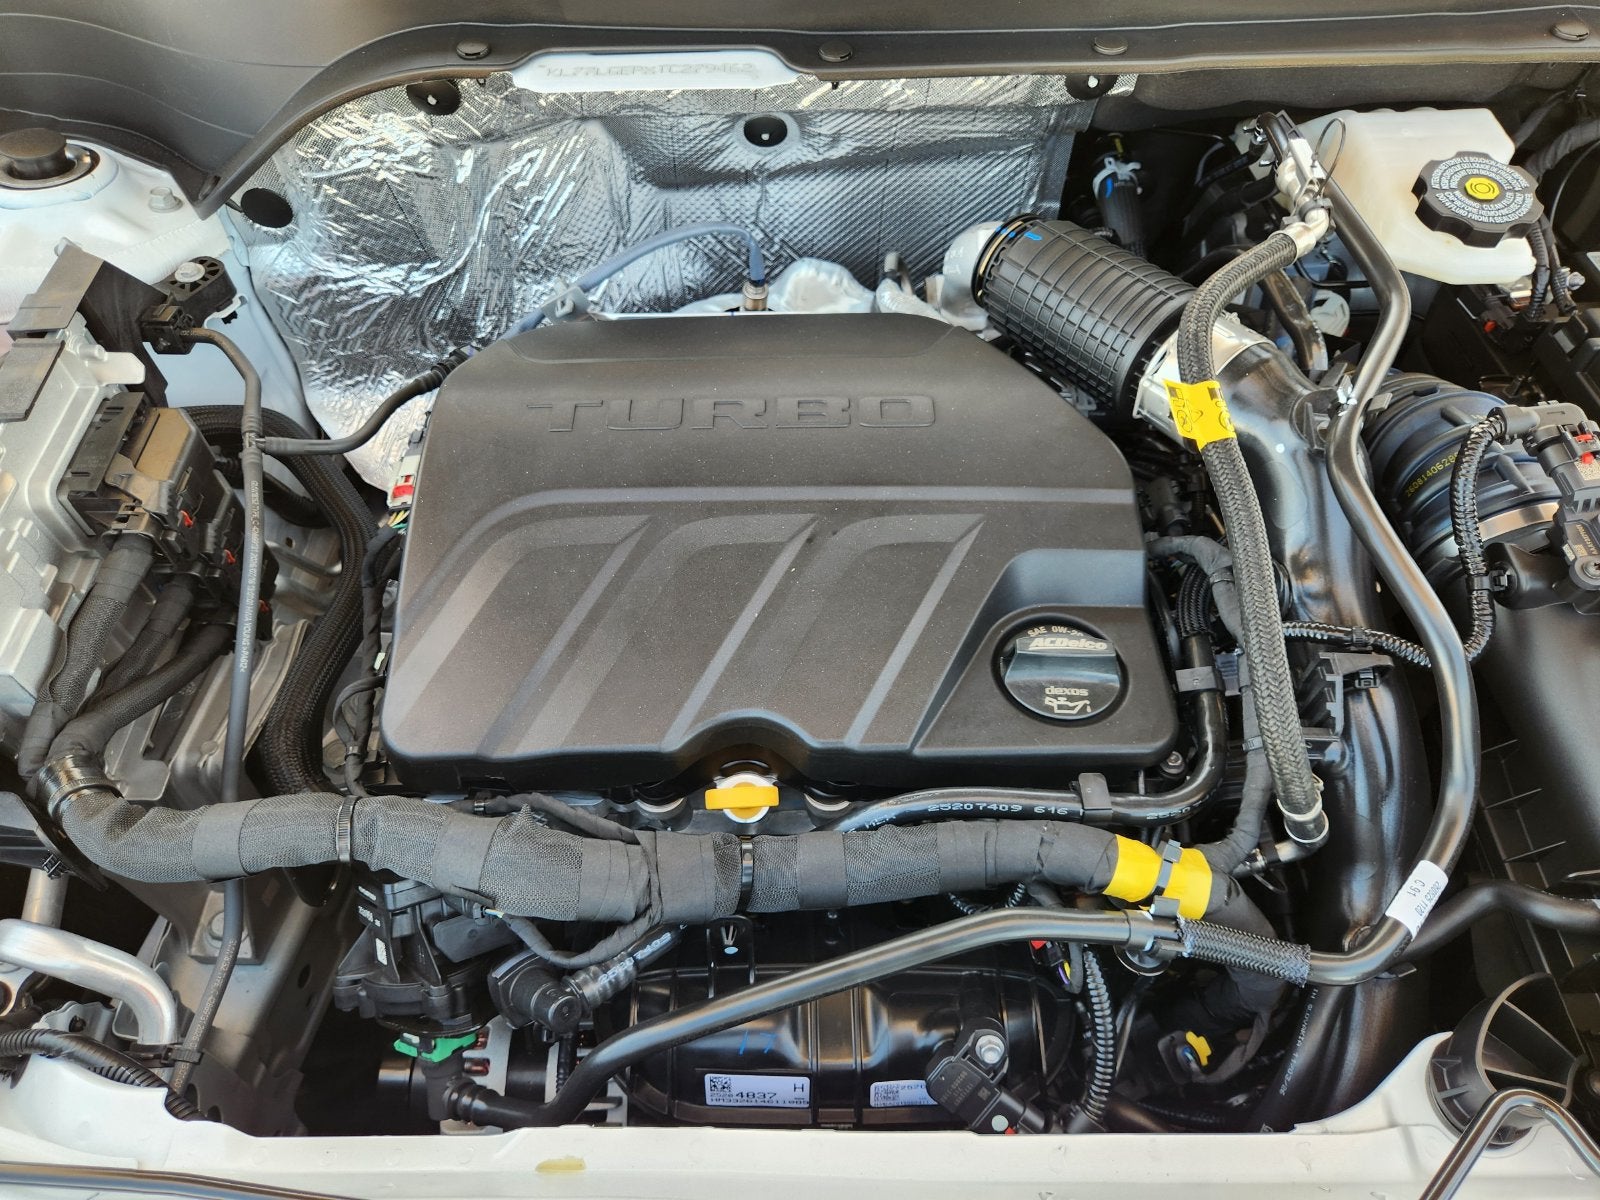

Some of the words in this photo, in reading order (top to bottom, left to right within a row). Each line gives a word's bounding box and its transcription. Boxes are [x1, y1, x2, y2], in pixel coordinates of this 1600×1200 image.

[526, 395, 936, 432] TURBO
[1027, 626, 1048, 637] SAE
[1029, 638, 1107, 650] ACDelco
[1045, 686, 1089, 696] dexos
[927, 802, 1023, 812] 25207409
[793, 1083, 805, 1092] H
[735, 1091, 777, 1099] 4837
